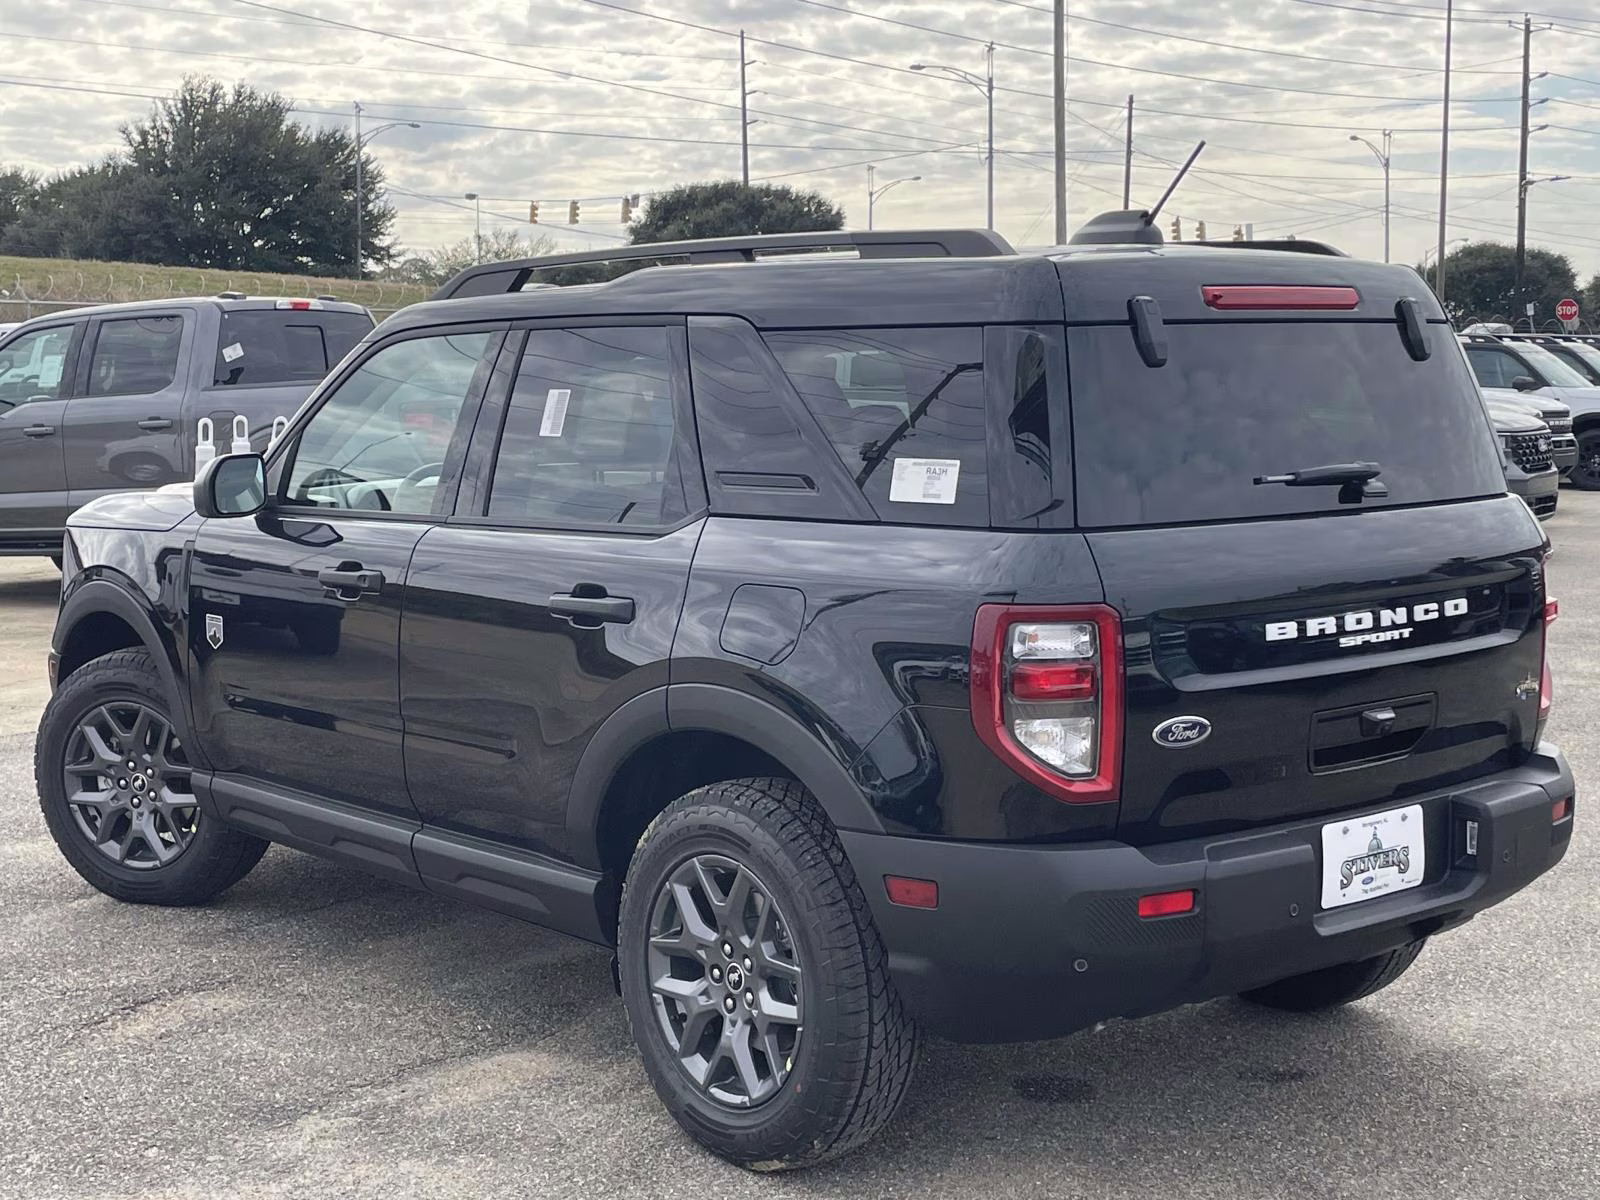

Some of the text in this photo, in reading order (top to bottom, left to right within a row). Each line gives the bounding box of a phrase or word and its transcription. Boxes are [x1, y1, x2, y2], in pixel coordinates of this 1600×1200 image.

[1558, 306, 1577, 315] STOP
[1265, 598, 1468, 642] BRONCO
[1339, 627, 1413, 648] SPORT
[1168, 723, 1200, 741] Ford
[1340, 845, 1410, 891] STIVERS
